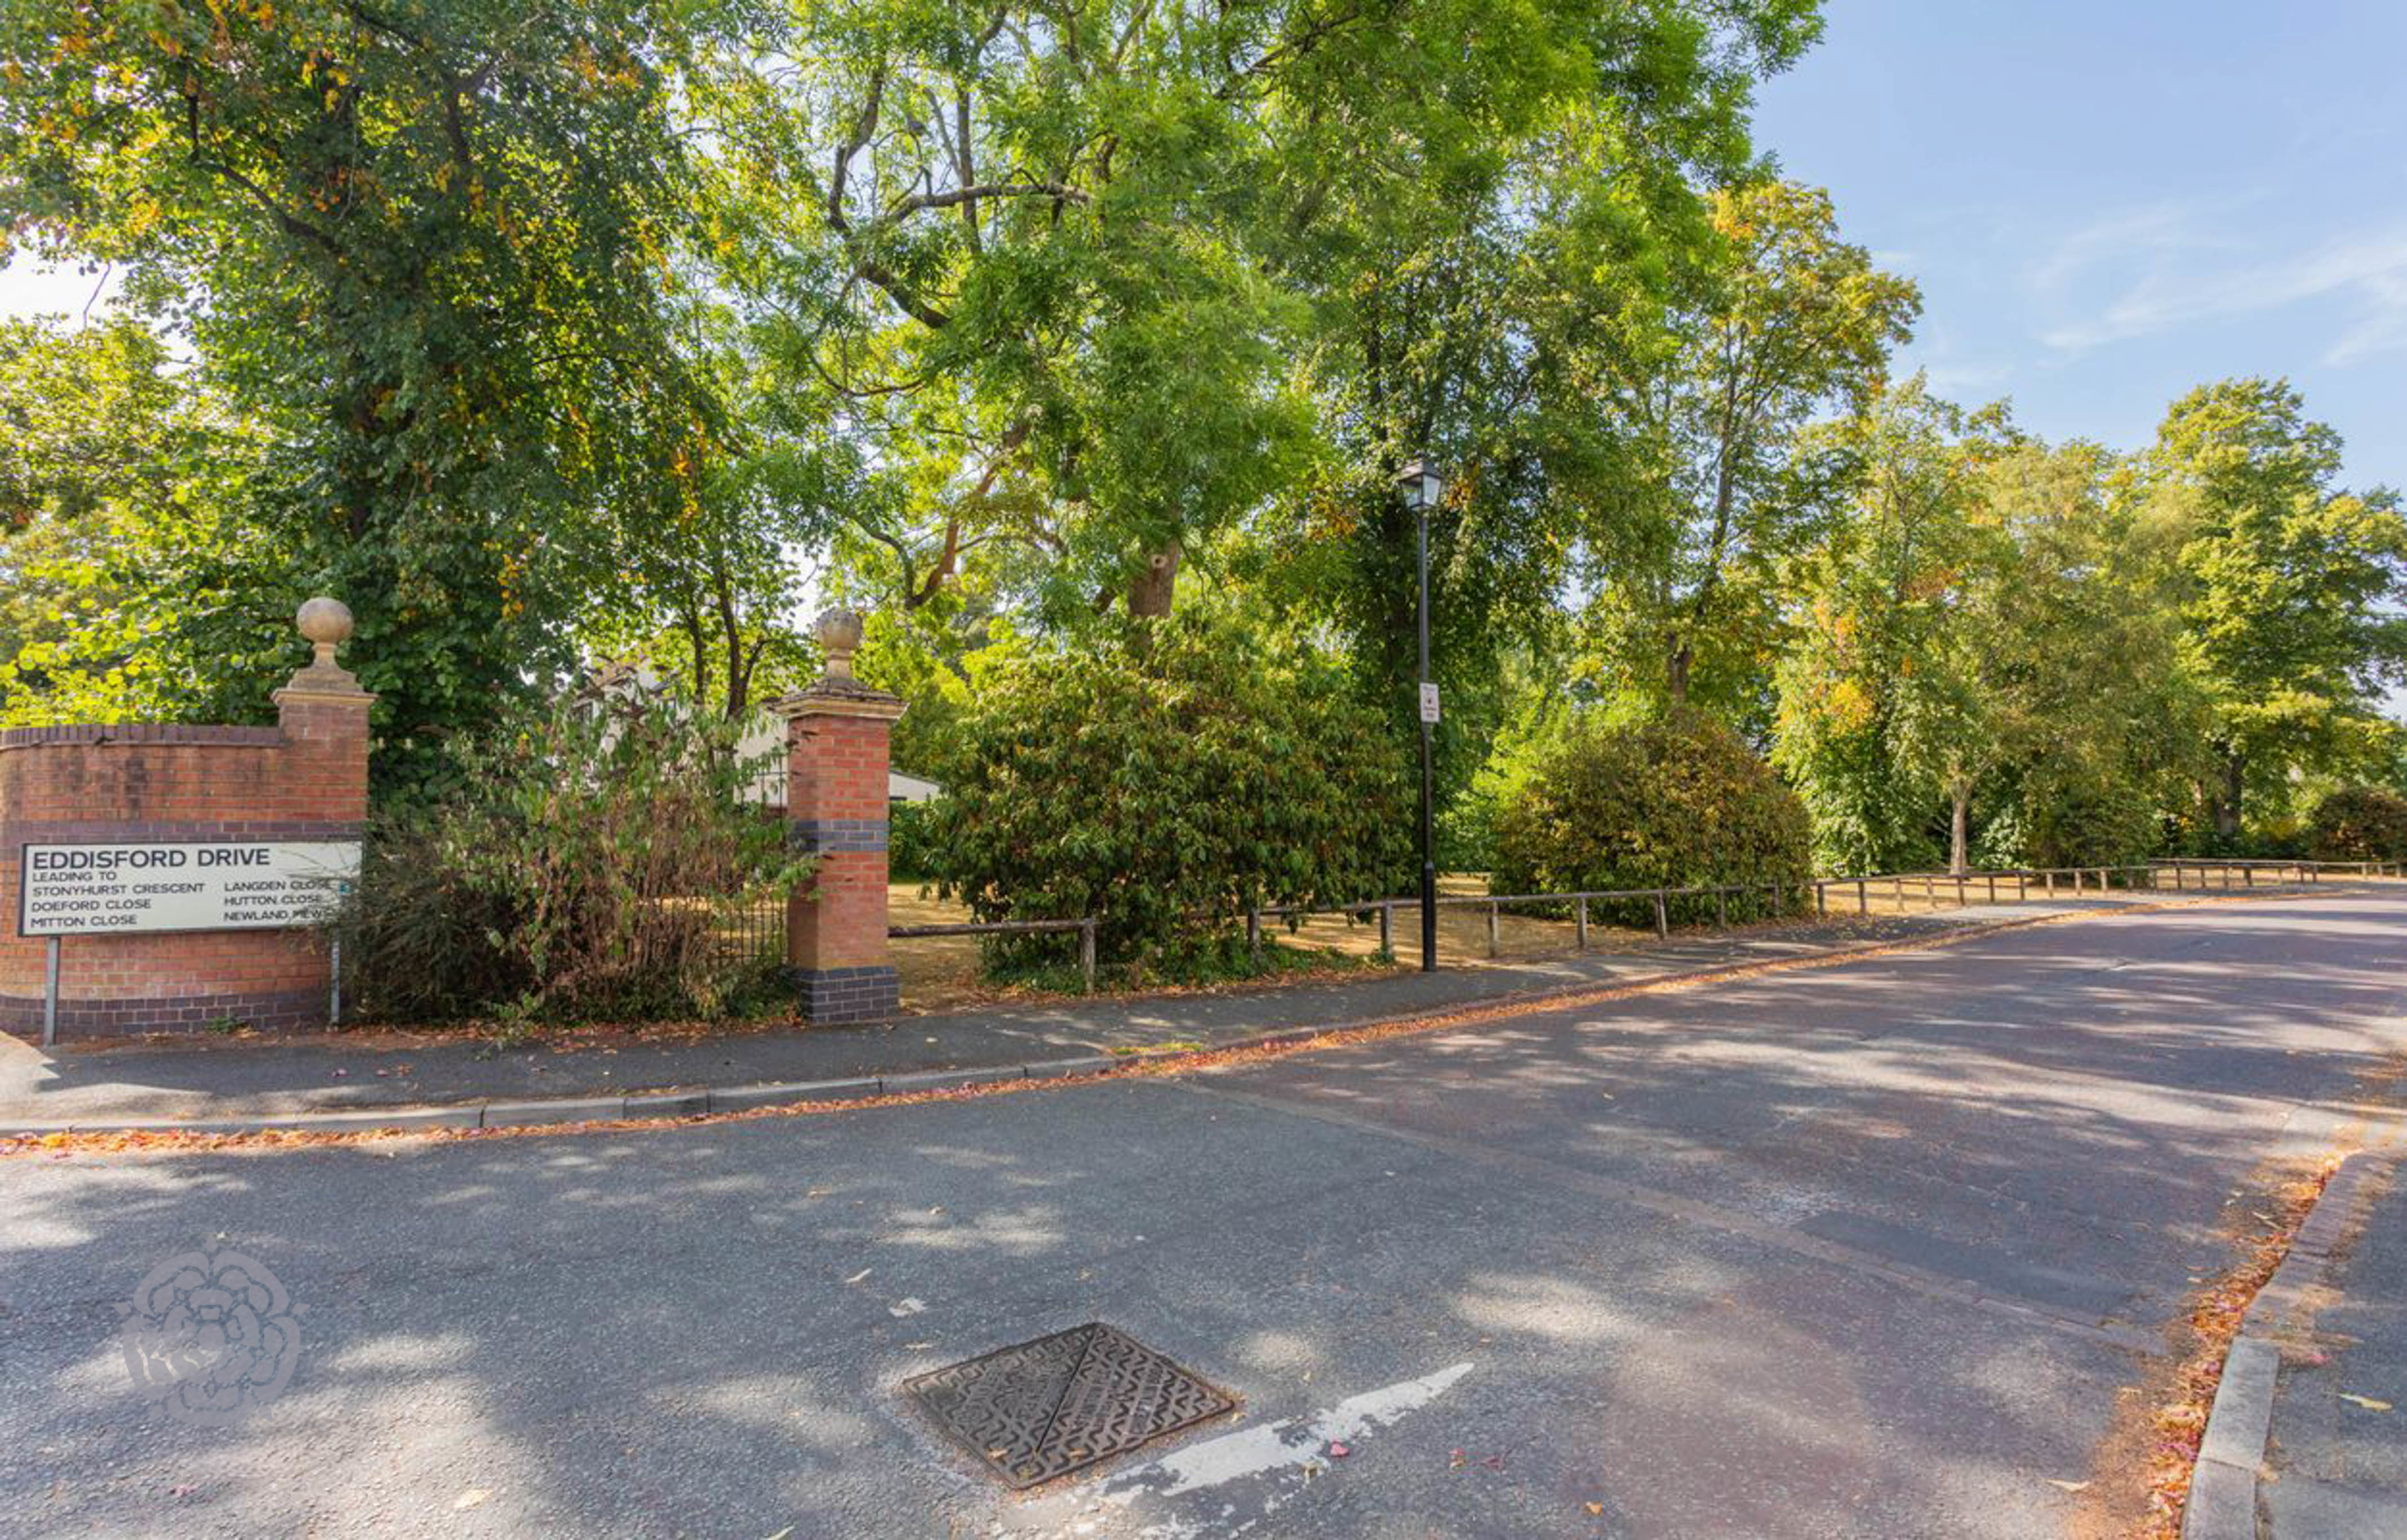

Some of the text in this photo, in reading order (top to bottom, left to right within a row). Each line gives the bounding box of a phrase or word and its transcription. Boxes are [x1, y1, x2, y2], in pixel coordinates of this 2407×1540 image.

[34, 849, 270, 869] EDDISFORD DRIVE
[33, 871, 116, 882] LEADING TO
[33, 883, 205, 896] STONYHURST CRESCENT
[224, 881, 286, 892] LANGDEN
[106, 899, 151, 909] CLOSE
[224, 895, 277, 905] HUTTON
[31, 915, 137, 928] MITTON CLOSE
[224, 910, 288, 922] NEWLAND
